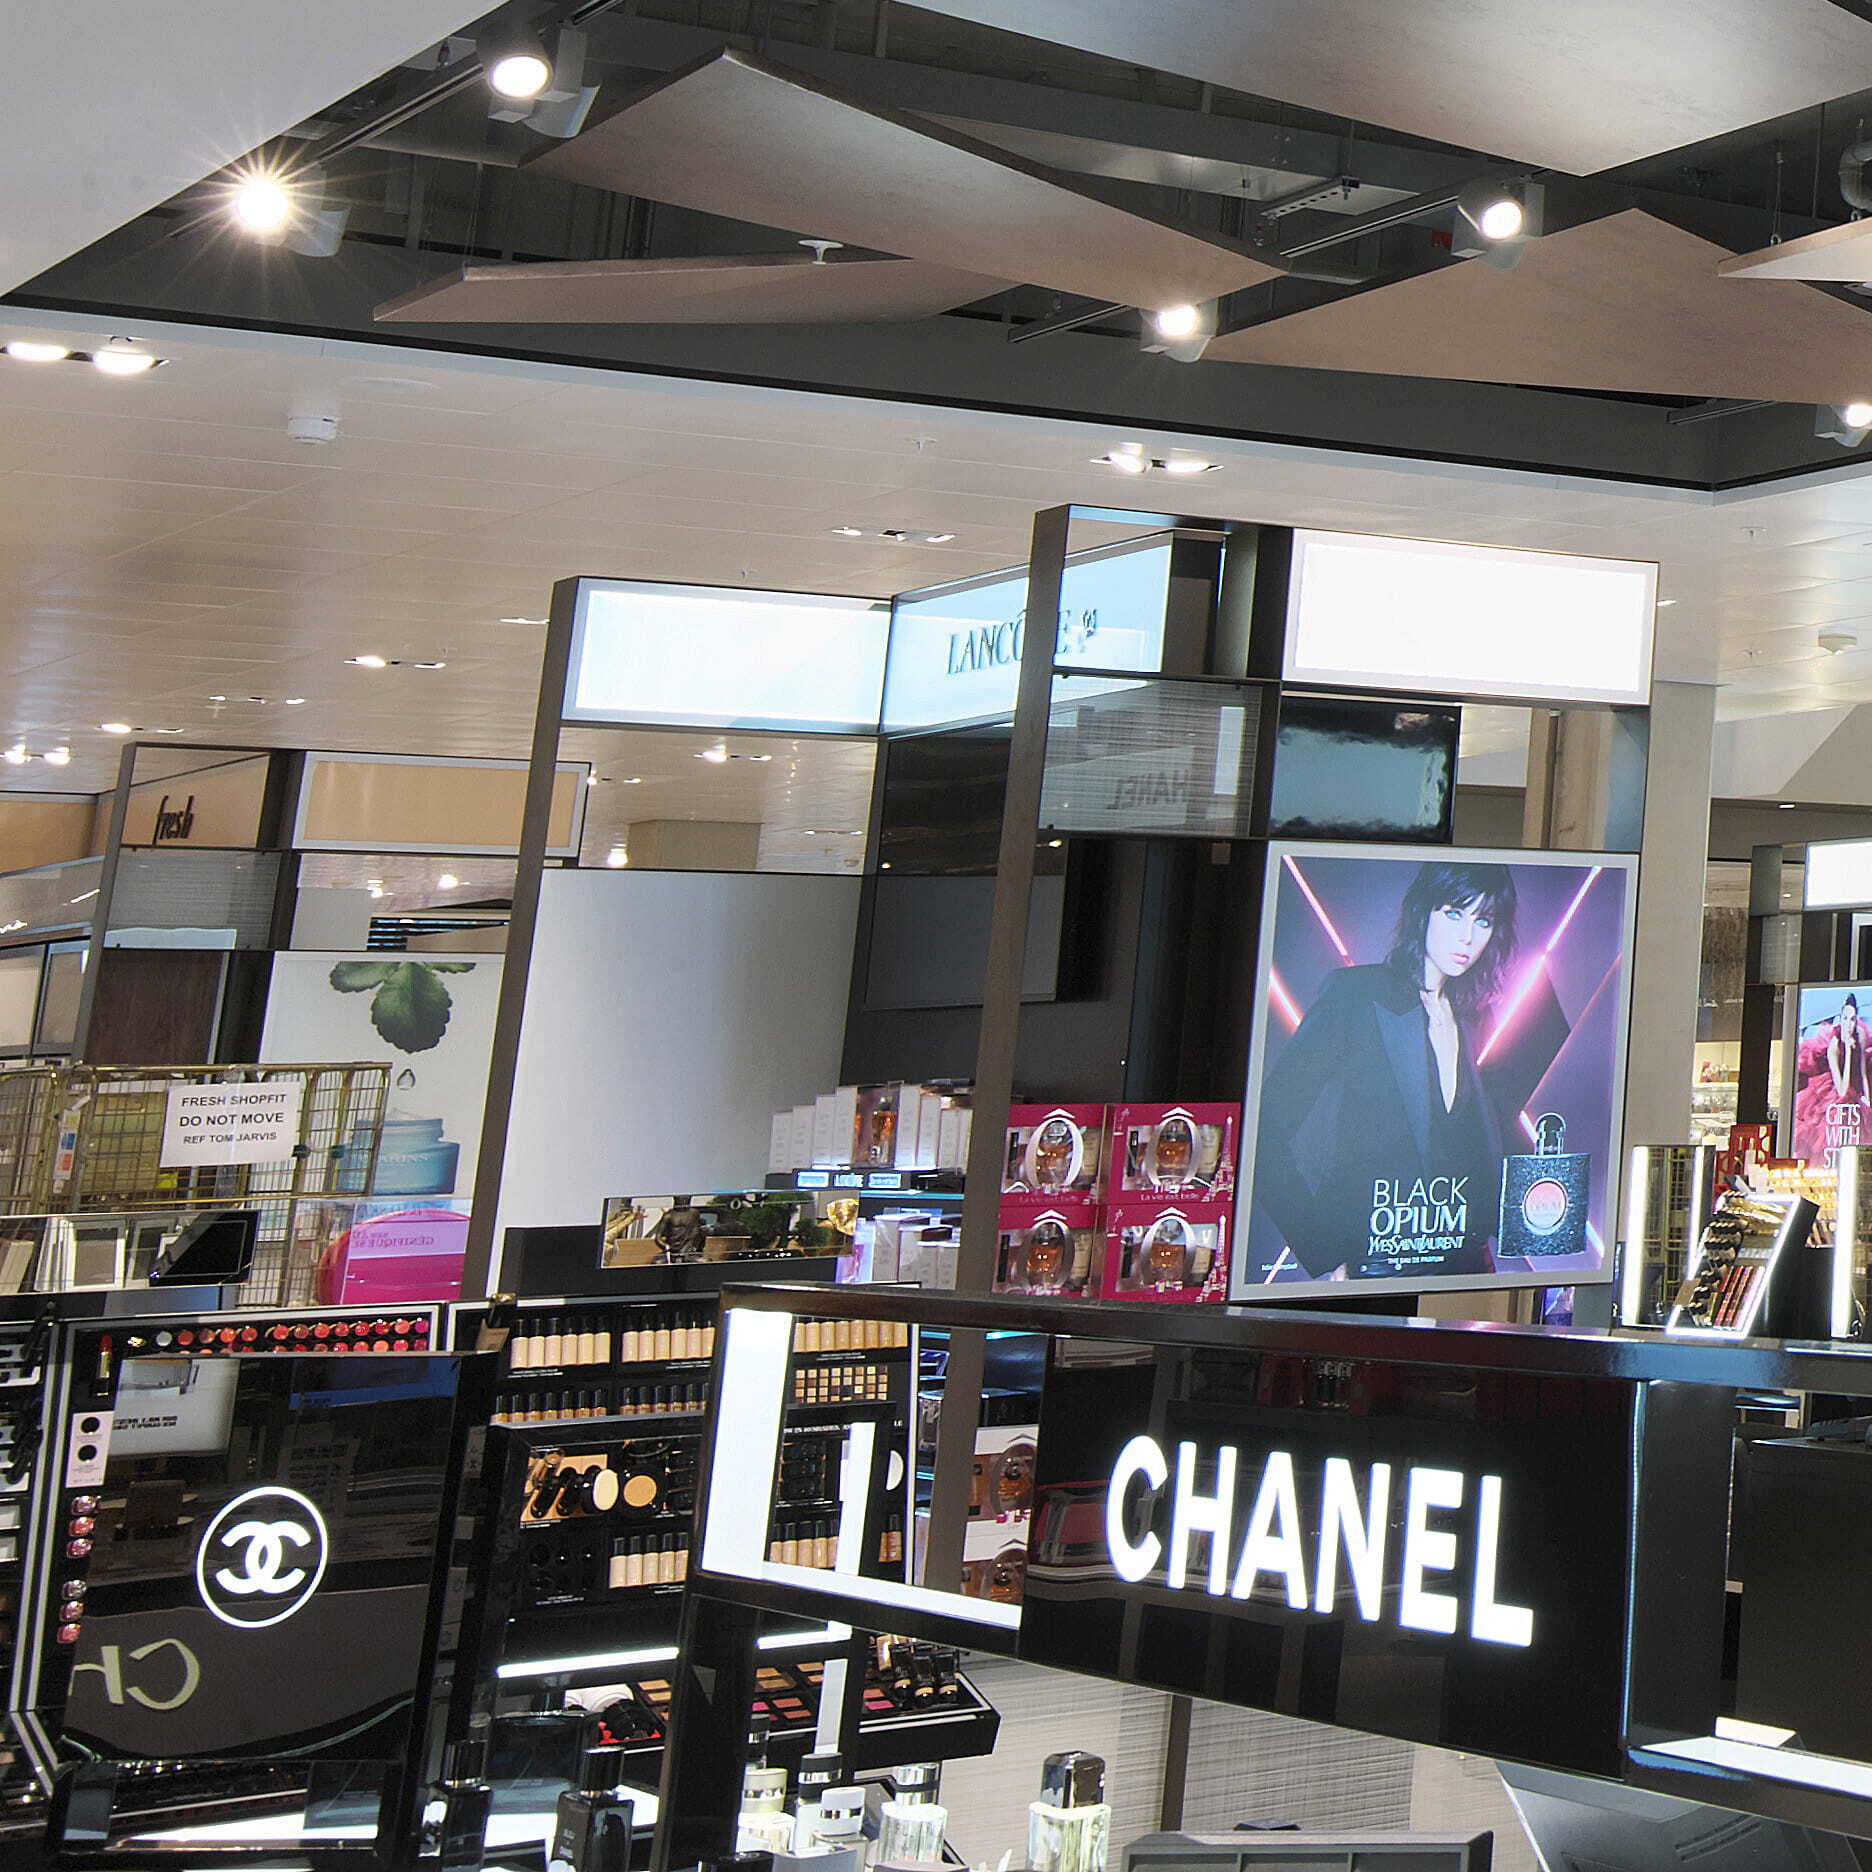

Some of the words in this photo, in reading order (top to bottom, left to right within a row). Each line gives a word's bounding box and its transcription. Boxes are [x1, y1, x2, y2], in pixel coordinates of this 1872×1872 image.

[152, 795, 194, 845] fresh
[181, 1096, 226, 1107] FRESH
[230, 1094, 287, 1106] SHOPFIT
[180, 1116, 202, 1127] DO
[206, 1114, 237, 1126] NOT
[241, 1112, 285, 1125] MOVE
[1825, 1104, 1861, 1125] GIFTS
[183, 1135, 206, 1144] REF
[209, 1134, 233, 1143] TOM
[236, 1132, 277, 1142] JARVIS
[1825, 1126, 1861, 1146] WITH
[1373, 1176, 1469, 1208] BLACK
[1370, 1204, 1467, 1236] OPIUM
[1105, 1434, 1534, 1647] CHANEL
